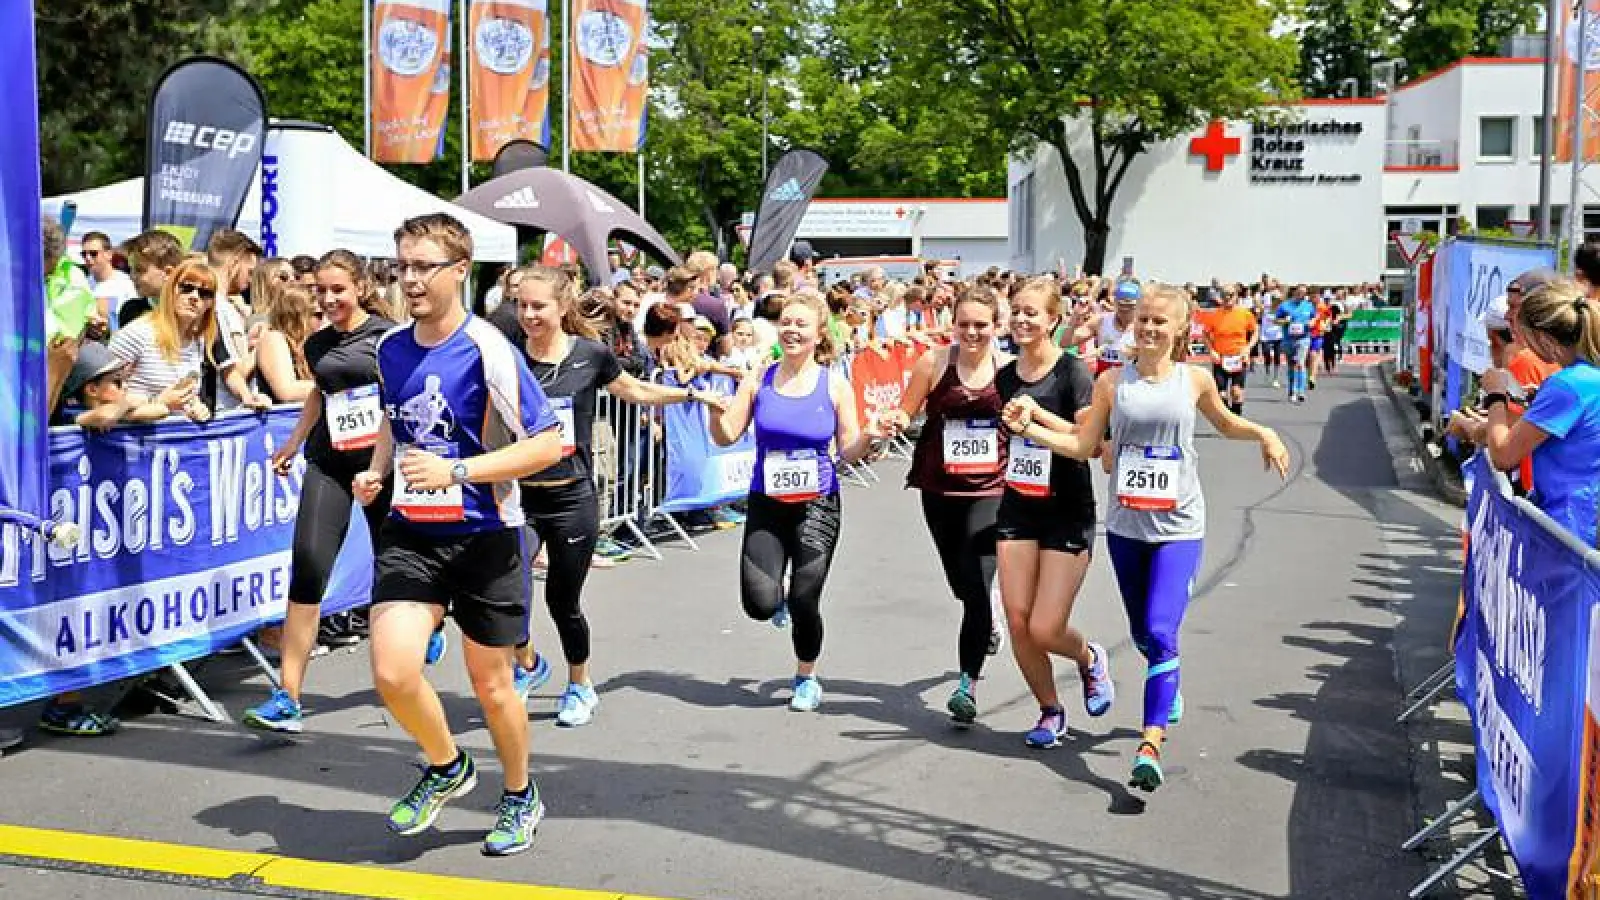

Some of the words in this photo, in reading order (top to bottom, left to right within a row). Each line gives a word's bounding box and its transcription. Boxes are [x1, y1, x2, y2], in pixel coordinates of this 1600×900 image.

[194, 125, 257, 159] cep
[1251, 137, 1305, 153] Rotes
[335, 408, 375, 433] 2511
[950, 438, 989, 457] 2509
[1011, 456, 1044, 478] 2506
[771, 470, 811, 489] 2507
[1125, 469, 1170, 491] 2510
[54, 565, 293, 658] ALKOHOLFRE
